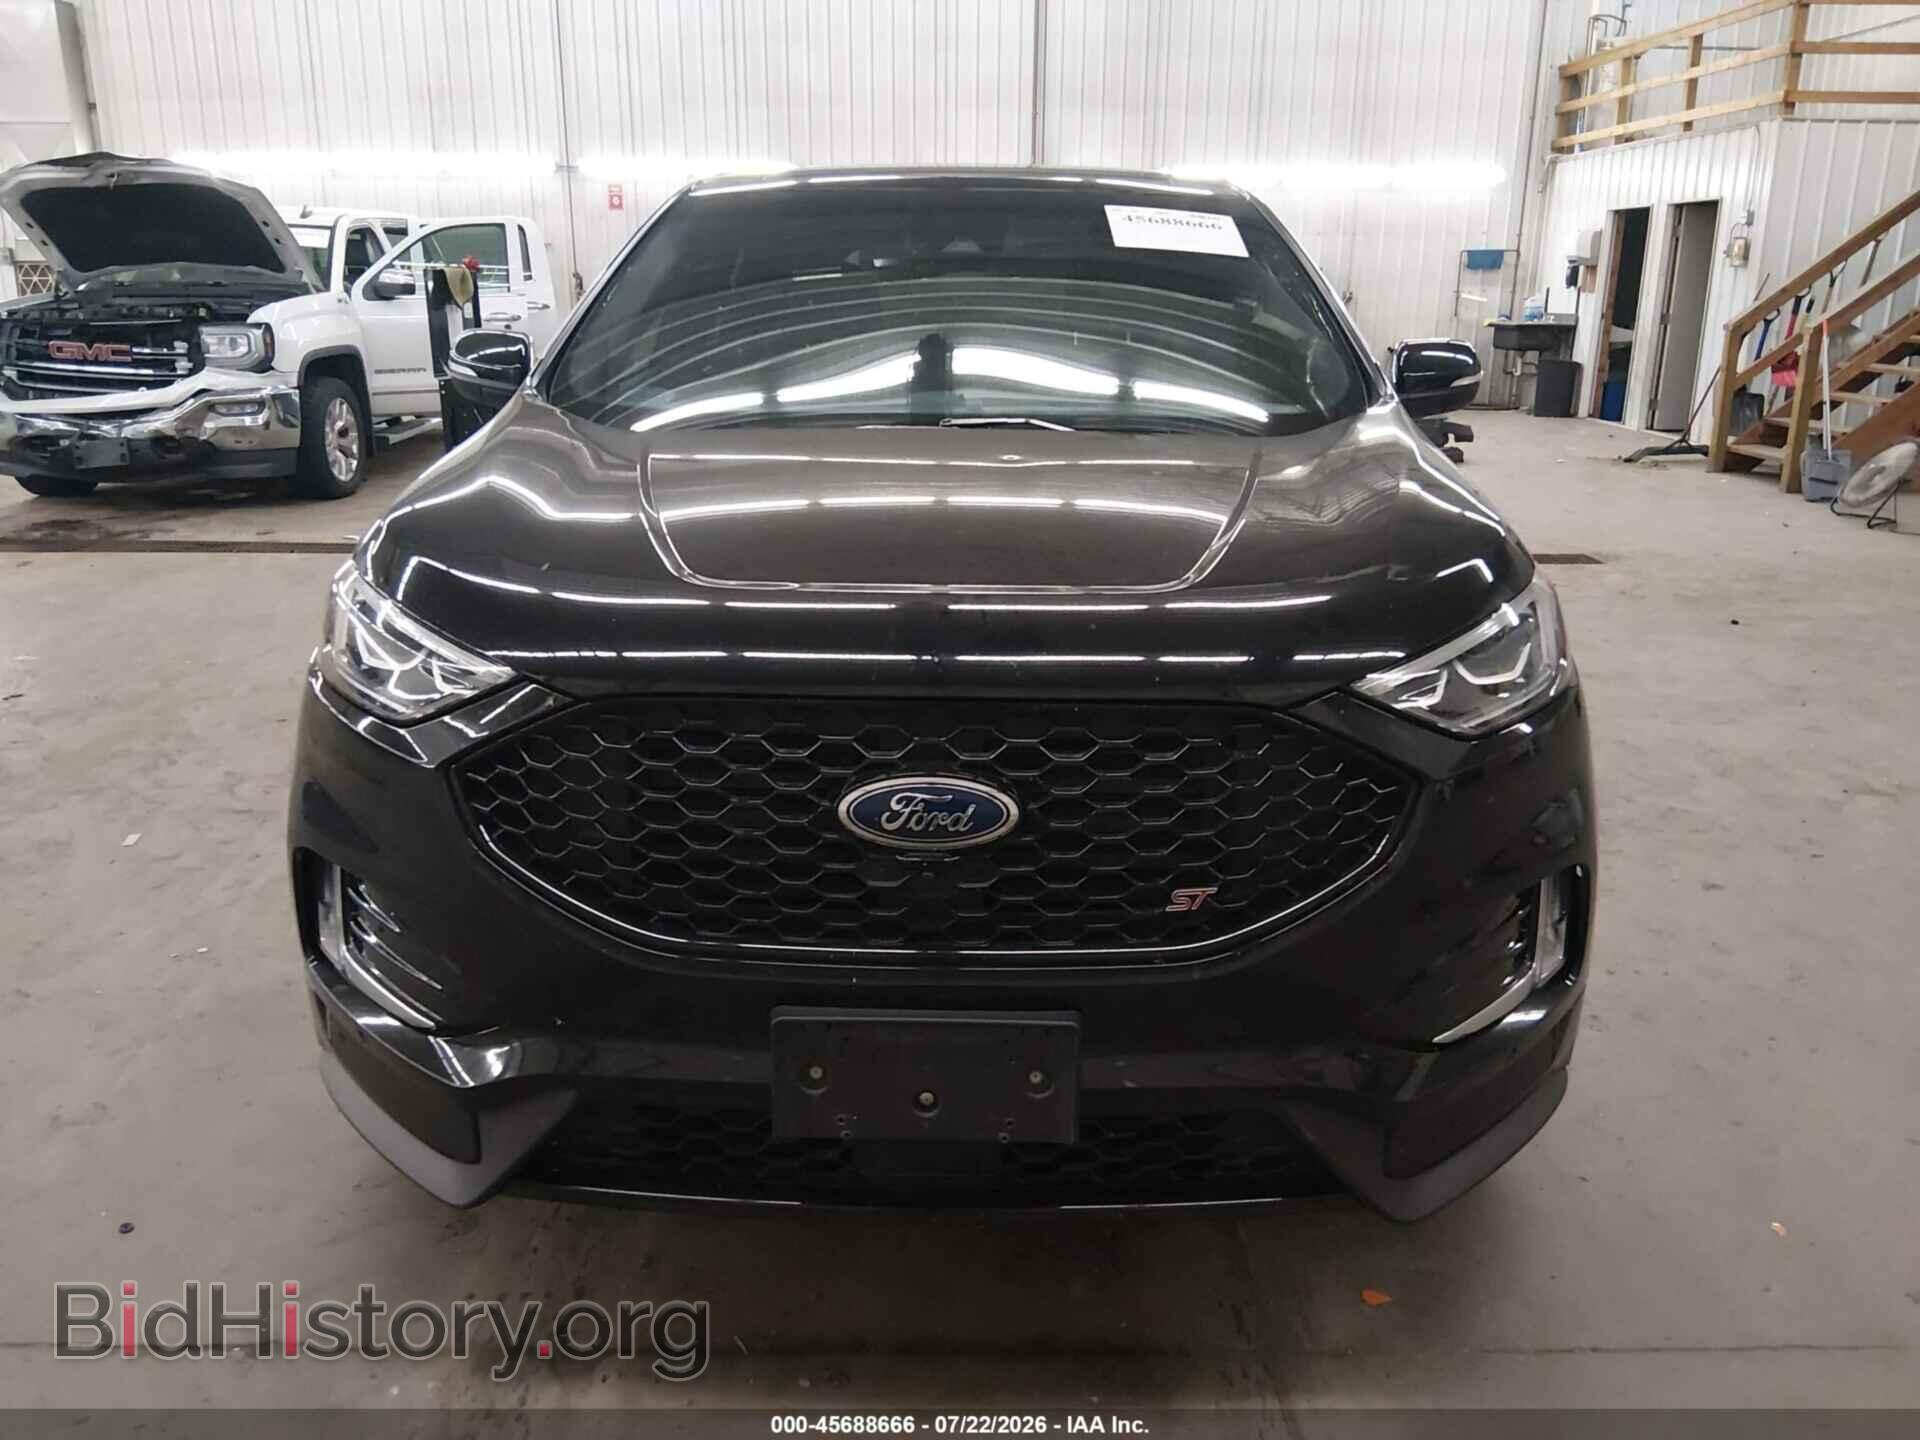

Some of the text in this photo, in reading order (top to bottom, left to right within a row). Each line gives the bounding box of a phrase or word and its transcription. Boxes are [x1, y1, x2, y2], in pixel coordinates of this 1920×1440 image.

[48, 341, 132, 362] GMC
[880, 792, 977, 831] Ford
[1165, 887, 1218, 912] ST
